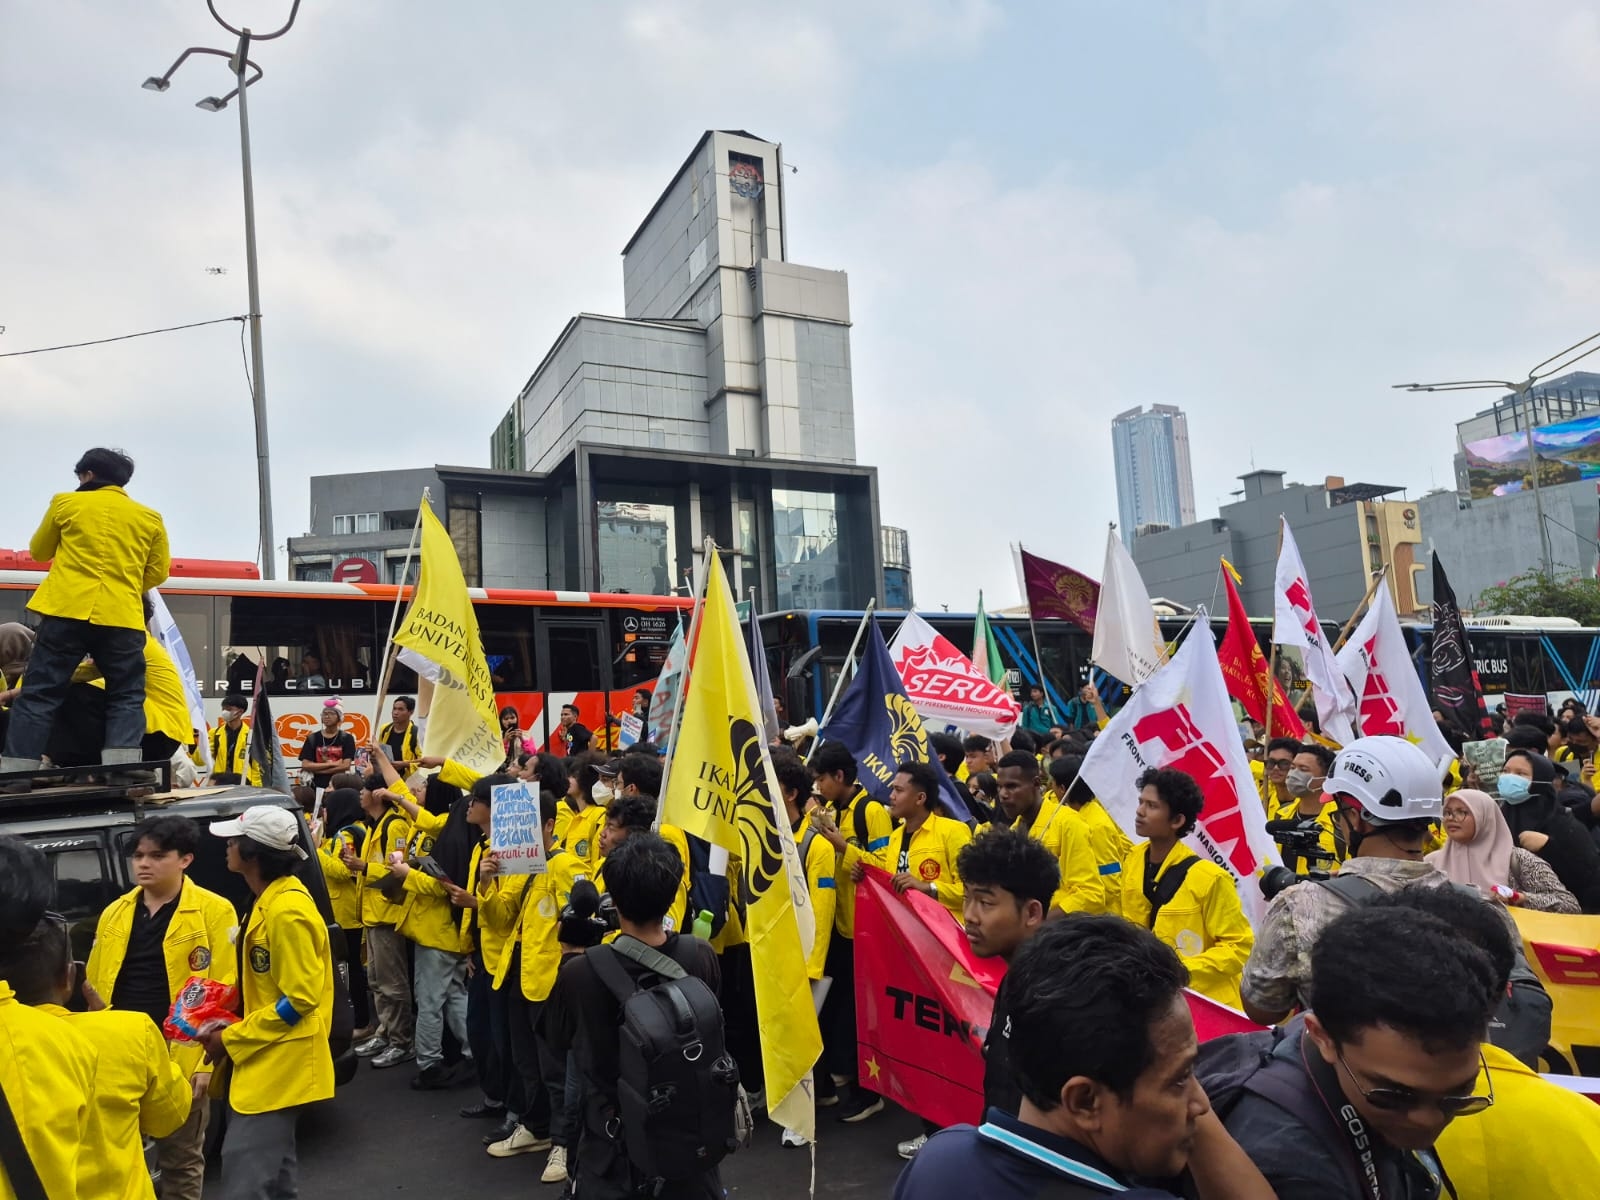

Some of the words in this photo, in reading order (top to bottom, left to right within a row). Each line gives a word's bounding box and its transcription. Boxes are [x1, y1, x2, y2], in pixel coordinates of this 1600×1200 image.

[416, 608, 466, 638] BADAN
[1491, 659, 1508, 673] BUS
[285, 679, 364, 690] CLUB
[1121, 732, 1146, 768] FRONT
[863, 752, 893, 783] IKM
[1344, 761, 1373, 783] PRESS
[1340, 1104, 1371, 1150] EOS
